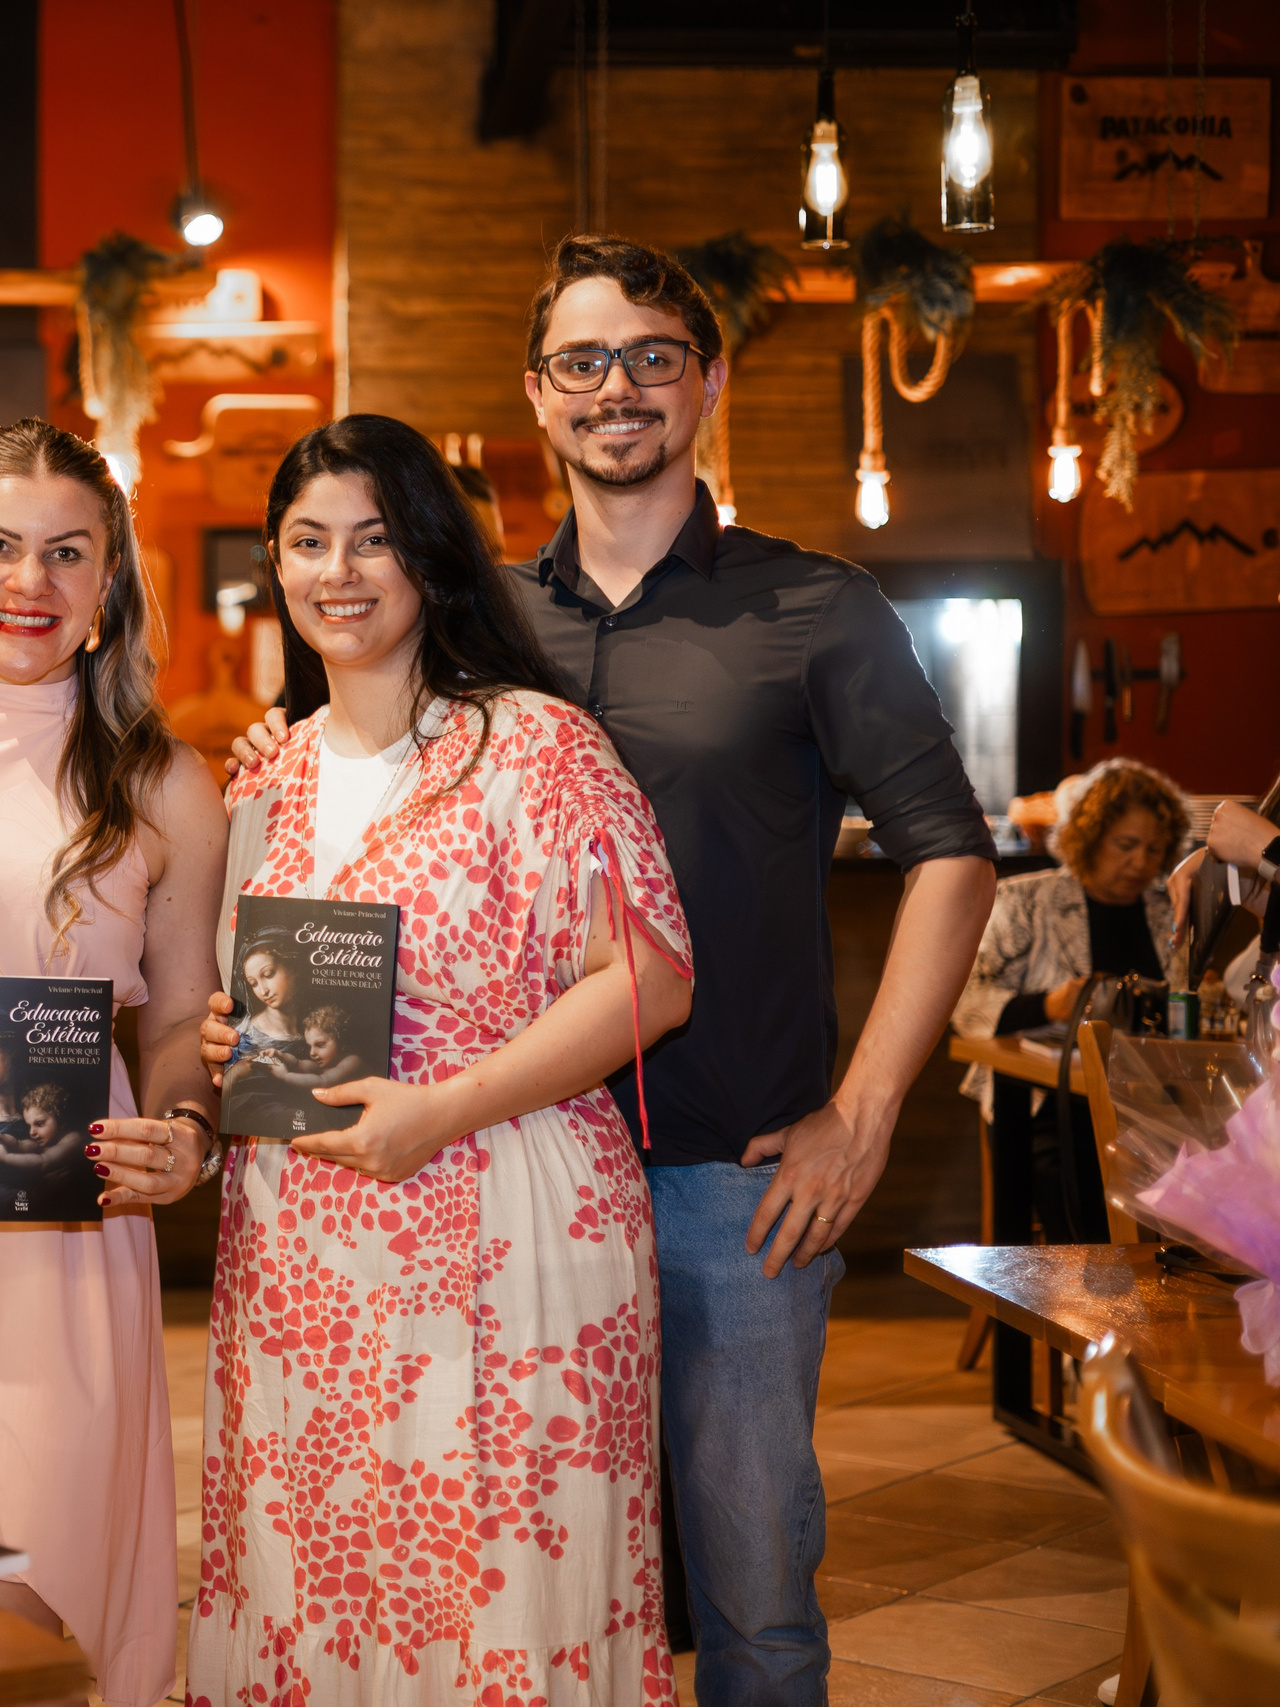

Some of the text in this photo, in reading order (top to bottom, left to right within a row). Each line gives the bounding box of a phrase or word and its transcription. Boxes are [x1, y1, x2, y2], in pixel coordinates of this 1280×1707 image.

[333, 909, 387, 919] Viviane Princival
[295, 921, 385, 951] Educação
[310, 944, 383, 968] Estética
[320, 969, 336, 978] QUE
[337, 968, 342, 977] É
[349, 971, 365, 979] POR
[366, 972, 383, 981] QUE
[311, 977, 382, 989] PRECISAMOS DELA?
[48, 986, 103, 994] Viviane Princival
[9, 1000, 102, 1027] Educação
[26, 1021, 101, 1045] Estética
[37, 1047, 53, 1056] QUE
[54, 1046, 60, 1055] É
[84, 1048, 101, 1057] QUE
[28, 1056, 101, 1065] PRECISAMOS DELA?
